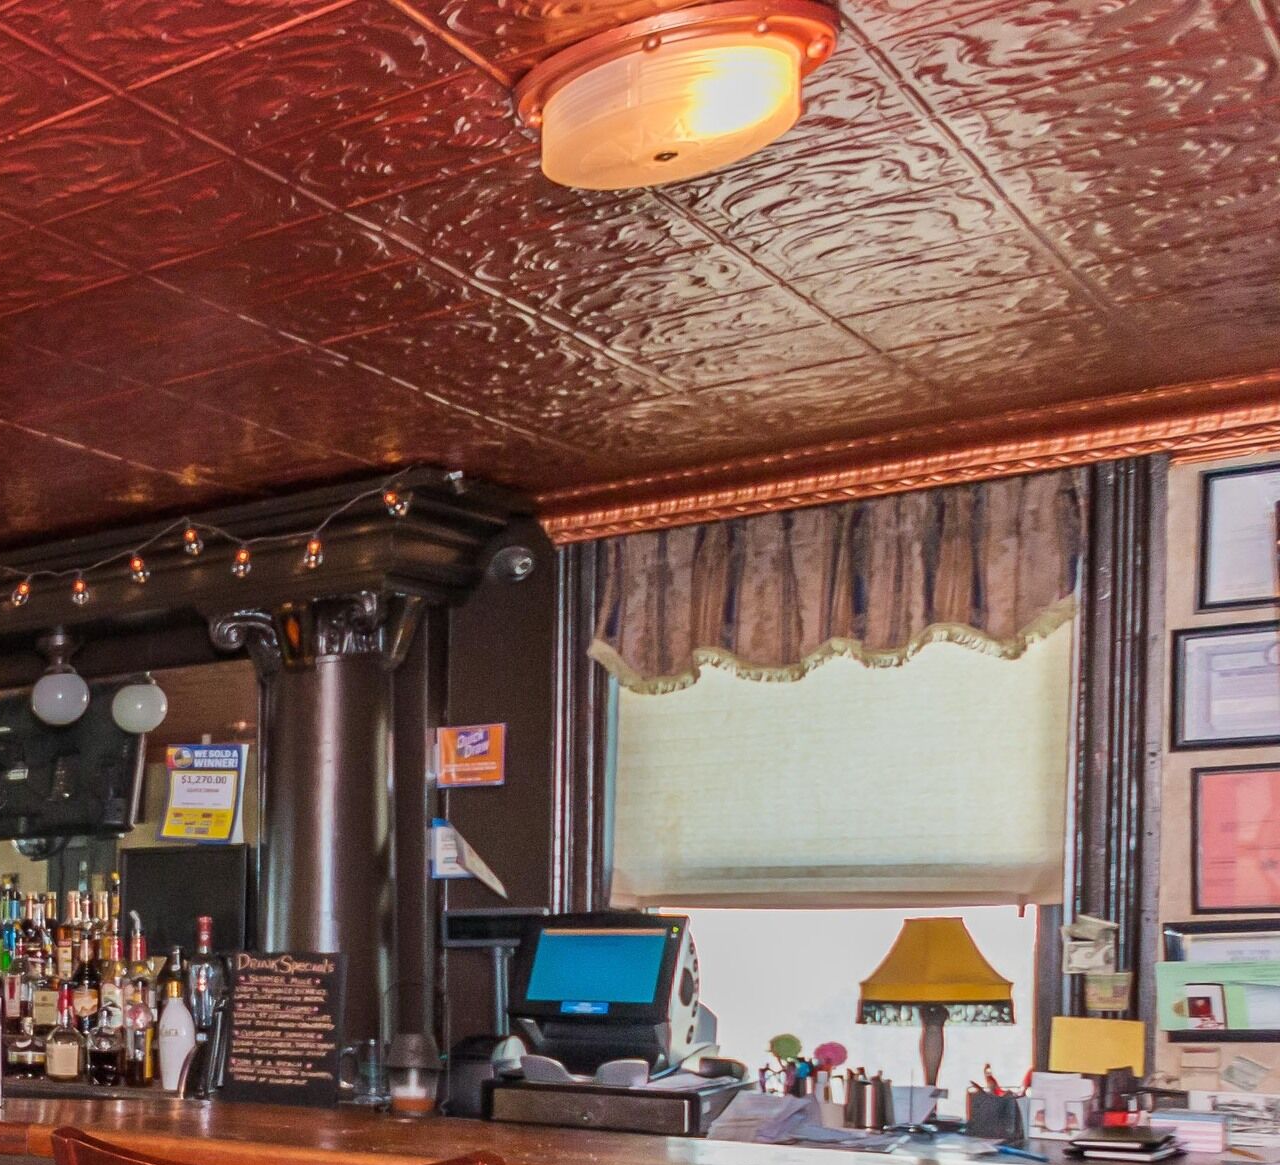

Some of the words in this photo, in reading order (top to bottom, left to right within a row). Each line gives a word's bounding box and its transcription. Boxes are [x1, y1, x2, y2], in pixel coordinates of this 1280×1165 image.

[194, 750, 208, 758] WE
[209, 750, 231, 758] SOLD
[232, 750, 239, 758] A
[194, 758, 239, 768] WINNER!
[181, 775, 227, 785] $1,270.00
